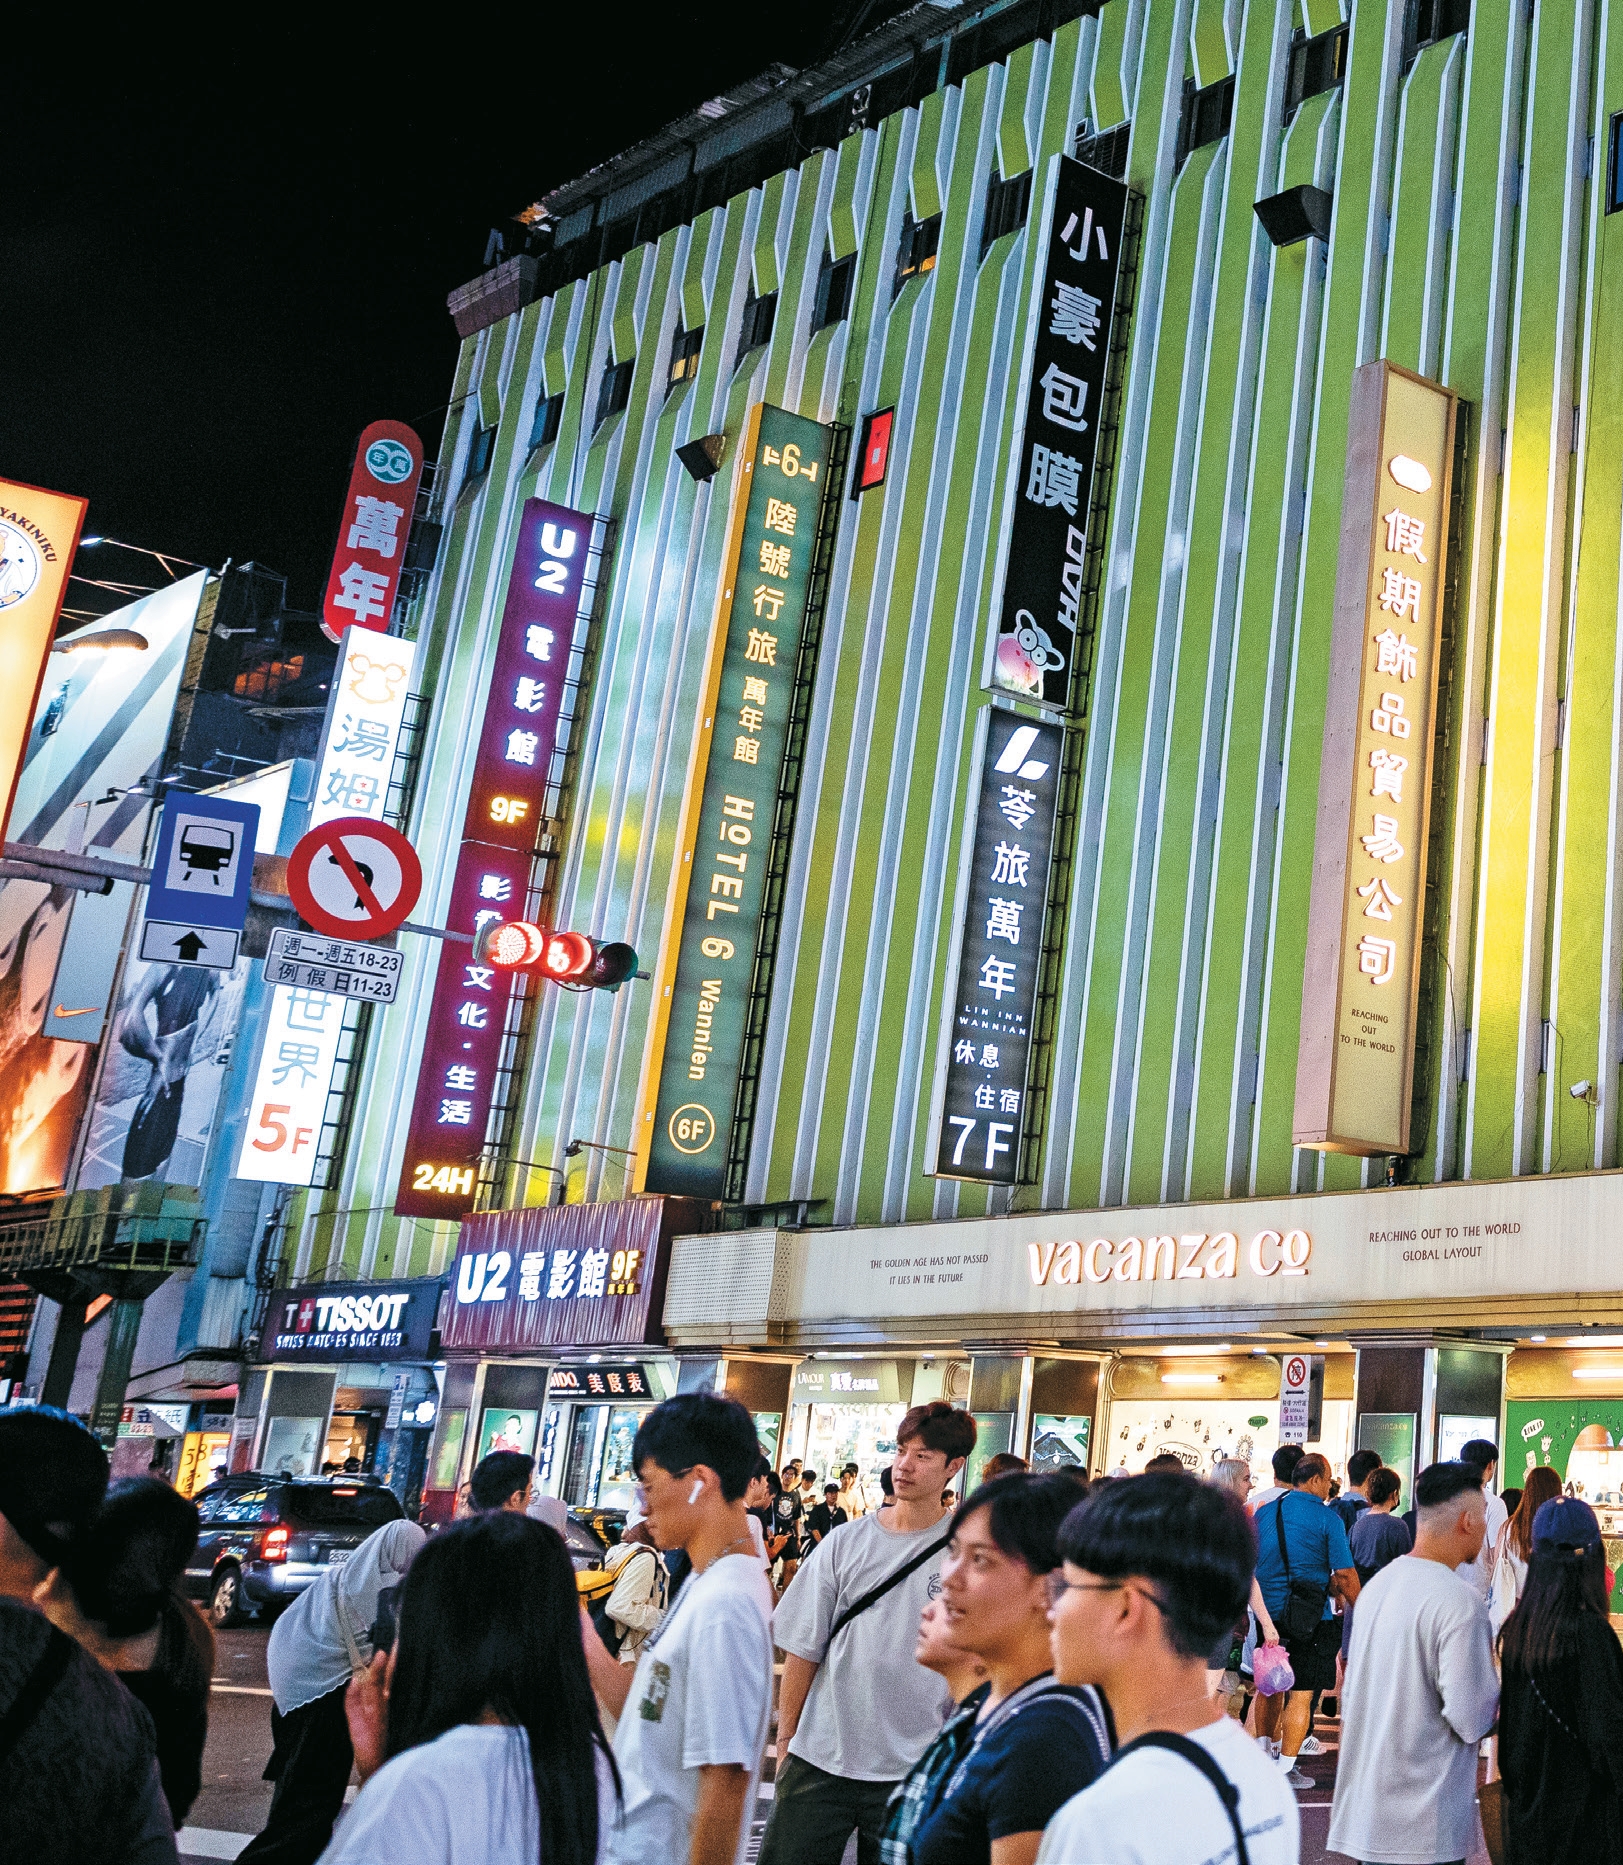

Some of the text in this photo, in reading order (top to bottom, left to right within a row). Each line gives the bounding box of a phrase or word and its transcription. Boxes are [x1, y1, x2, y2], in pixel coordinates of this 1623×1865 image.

[1025, 207, 1109, 517] 小豪包膜
[0, 507, 57, 562] YAKINIKU
[333, 496, 405, 624] 萬年
[745, 497, 797, 667] 陸號行旅
[489, 522, 577, 824] U2 電影館 9F
[733, 676, 768, 764] 萬年館
[323, 713, 391, 813] 湯姆
[1356, 506, 1427, 987] 假期飾品貿易公司
[979, 785, 1036, 1001] 苓旅萬年
[688, 794, 755, 1081] HOTEL 6 Wannien
[960, 1017, 1026, 1035] WANNIAN
[965, 1005, 1022, 1022] LIN INN
[1352, 1009, 1388, 1023] REACHING
[1362, 1025, 1376, 1034] OUT
[271, 986, 332, 1089] 世界
[955, 1040, 999, 1068] 休息
[1341, 1035, 1395, 1053] TO THE WORLD
[975, 1084, 1020, 1114] 住宿
[252, 1104, 314, 1154] 5F
[677, 1119, 704, 1140] 6F
[949, 1115, 1014, 1171] 7F
[412, 1164, 474, 1196] 24H
[1368, 1222, 1522, 1243] REACHING OUT TO THE WORLD
[611, 1250, 639, 1281] 9F
[870, 1254, 989, 1269] THE GOLDEN AGE HAS NOT PASSED
[1028, 1226, 1312, 1286] vacanza co
[1403, 1246, 1483, 1263] GLOBAL LAYOUT
[457, 1248, 609, 1304] U2 電影館
[889, 1273, 963, 1285] IT LIES IN THE FUTURE
[316, 1294, 410, 1332] TISSOT
[380, 1332, 402, 1347] 1853
[588, 1372, 645, 1394] 美度表
